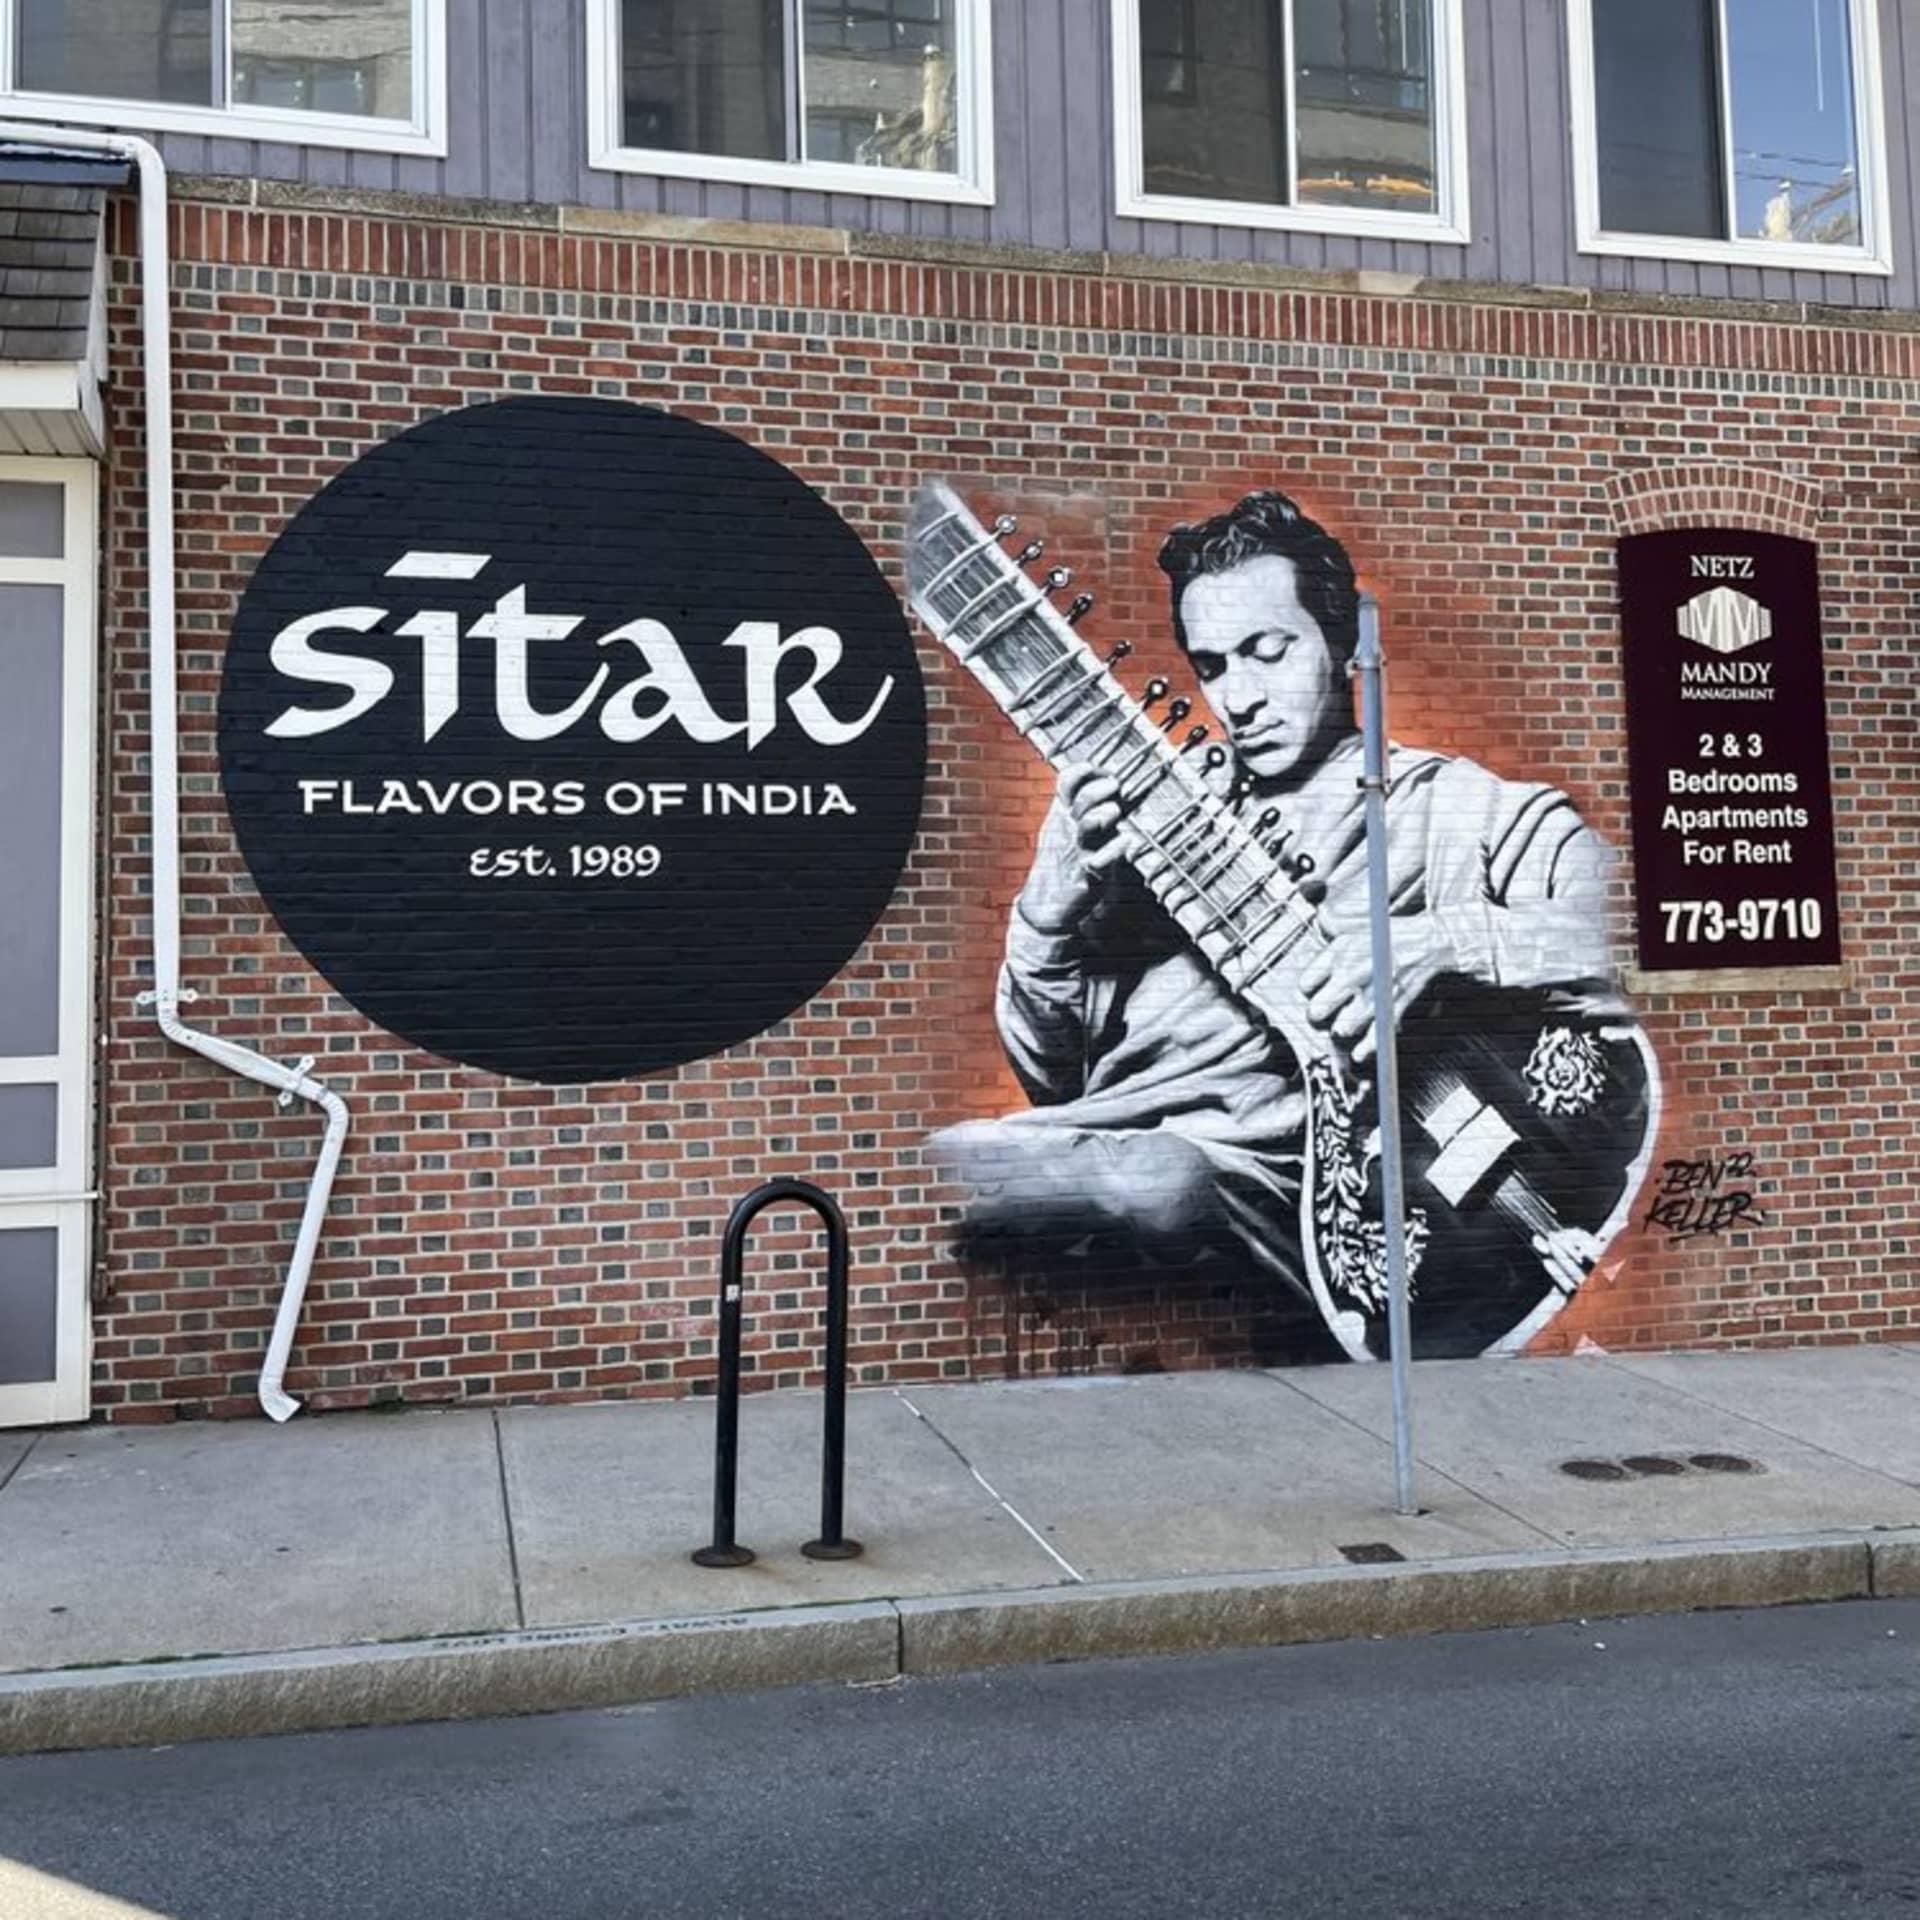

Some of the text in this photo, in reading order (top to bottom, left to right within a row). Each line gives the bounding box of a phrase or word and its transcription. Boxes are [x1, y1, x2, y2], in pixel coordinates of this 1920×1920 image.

[1690, 555, 1755, 578] NETZ
[1681, 662, 1772, 684] MANDY
[1699, 734, 1763, 758] 2 & 3
[1668, 769, 1798, 794] Bedrooms
[297, 780, 857, 816] FLAVORS OF INDIA
[1661, 804, 1809, 835] Apartments
[569, 845, 661, 878] 1989
[1683, 839, 1793, 865] For Rent
[1659, 898, 1822, 943] 773-9710
[1660, 1159, 1727, 1195] BEN
[1643, 1191, 1766, 1238] KELLER
